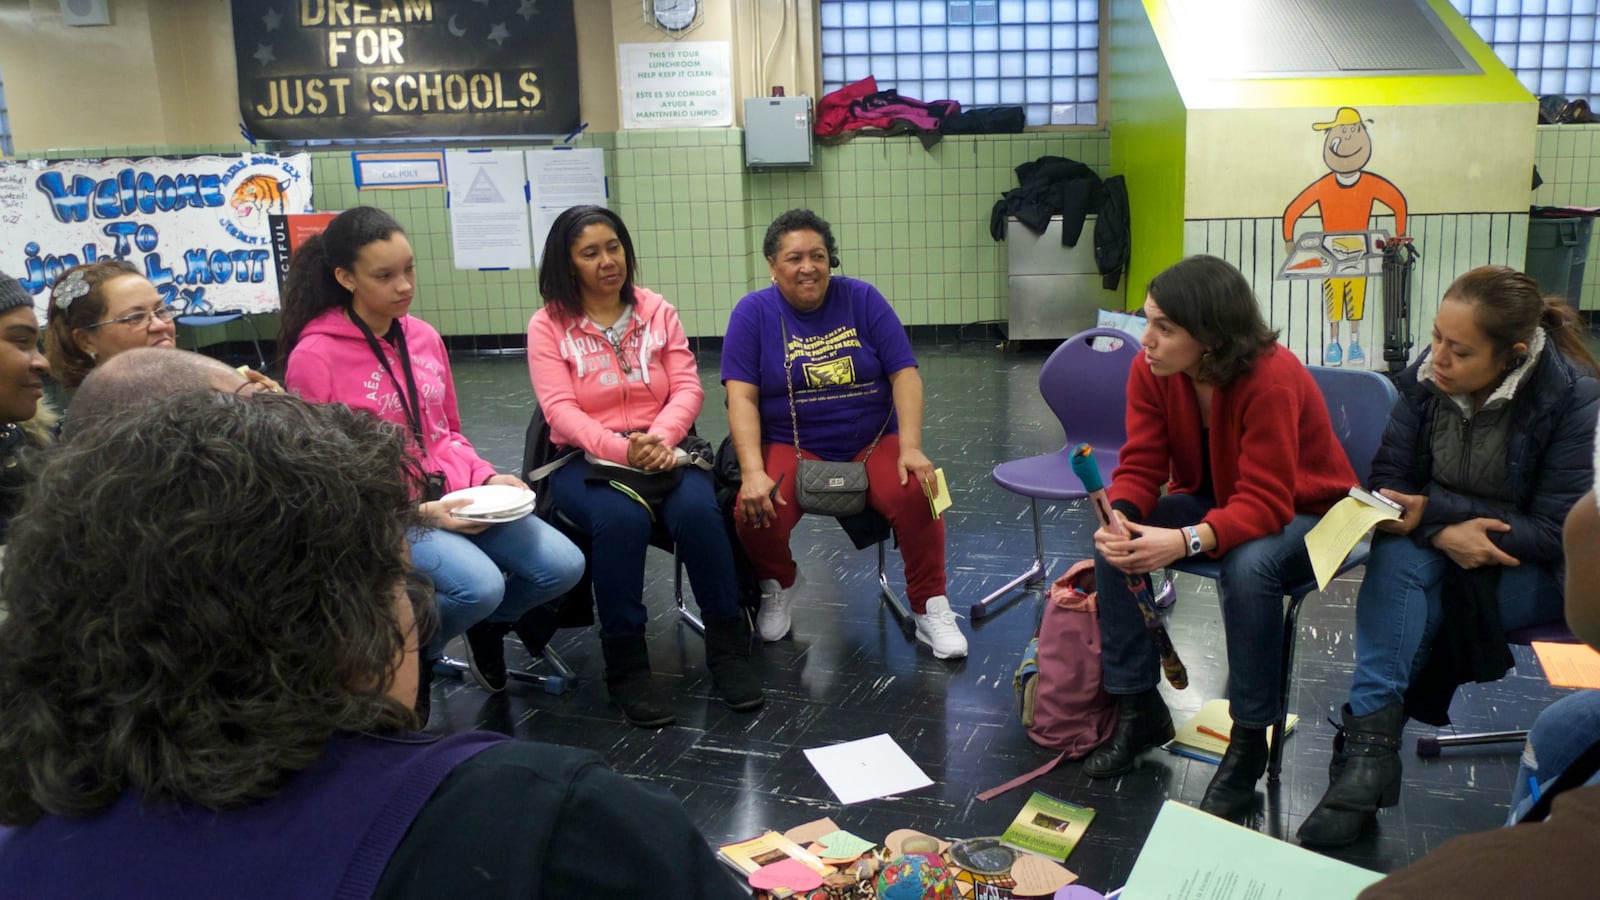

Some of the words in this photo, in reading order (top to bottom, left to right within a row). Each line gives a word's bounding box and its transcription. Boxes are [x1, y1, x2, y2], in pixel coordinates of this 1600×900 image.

[301, 0, 433, 27] DREAM
[328, 28, 405, 67] FOR
[648, 61, 701, 69] LUNCHROOM
[256, 77, 350, 117] JUST
[370, 71, 542, 113] SCHOOLS
[636, 91, 653, 99] ESTE
[665, 90, 676, 98] SU
[382, 171, 397, 179] CAL
[399, 169, 419, 177] POLY
[103, 221, 158, 256] TO
